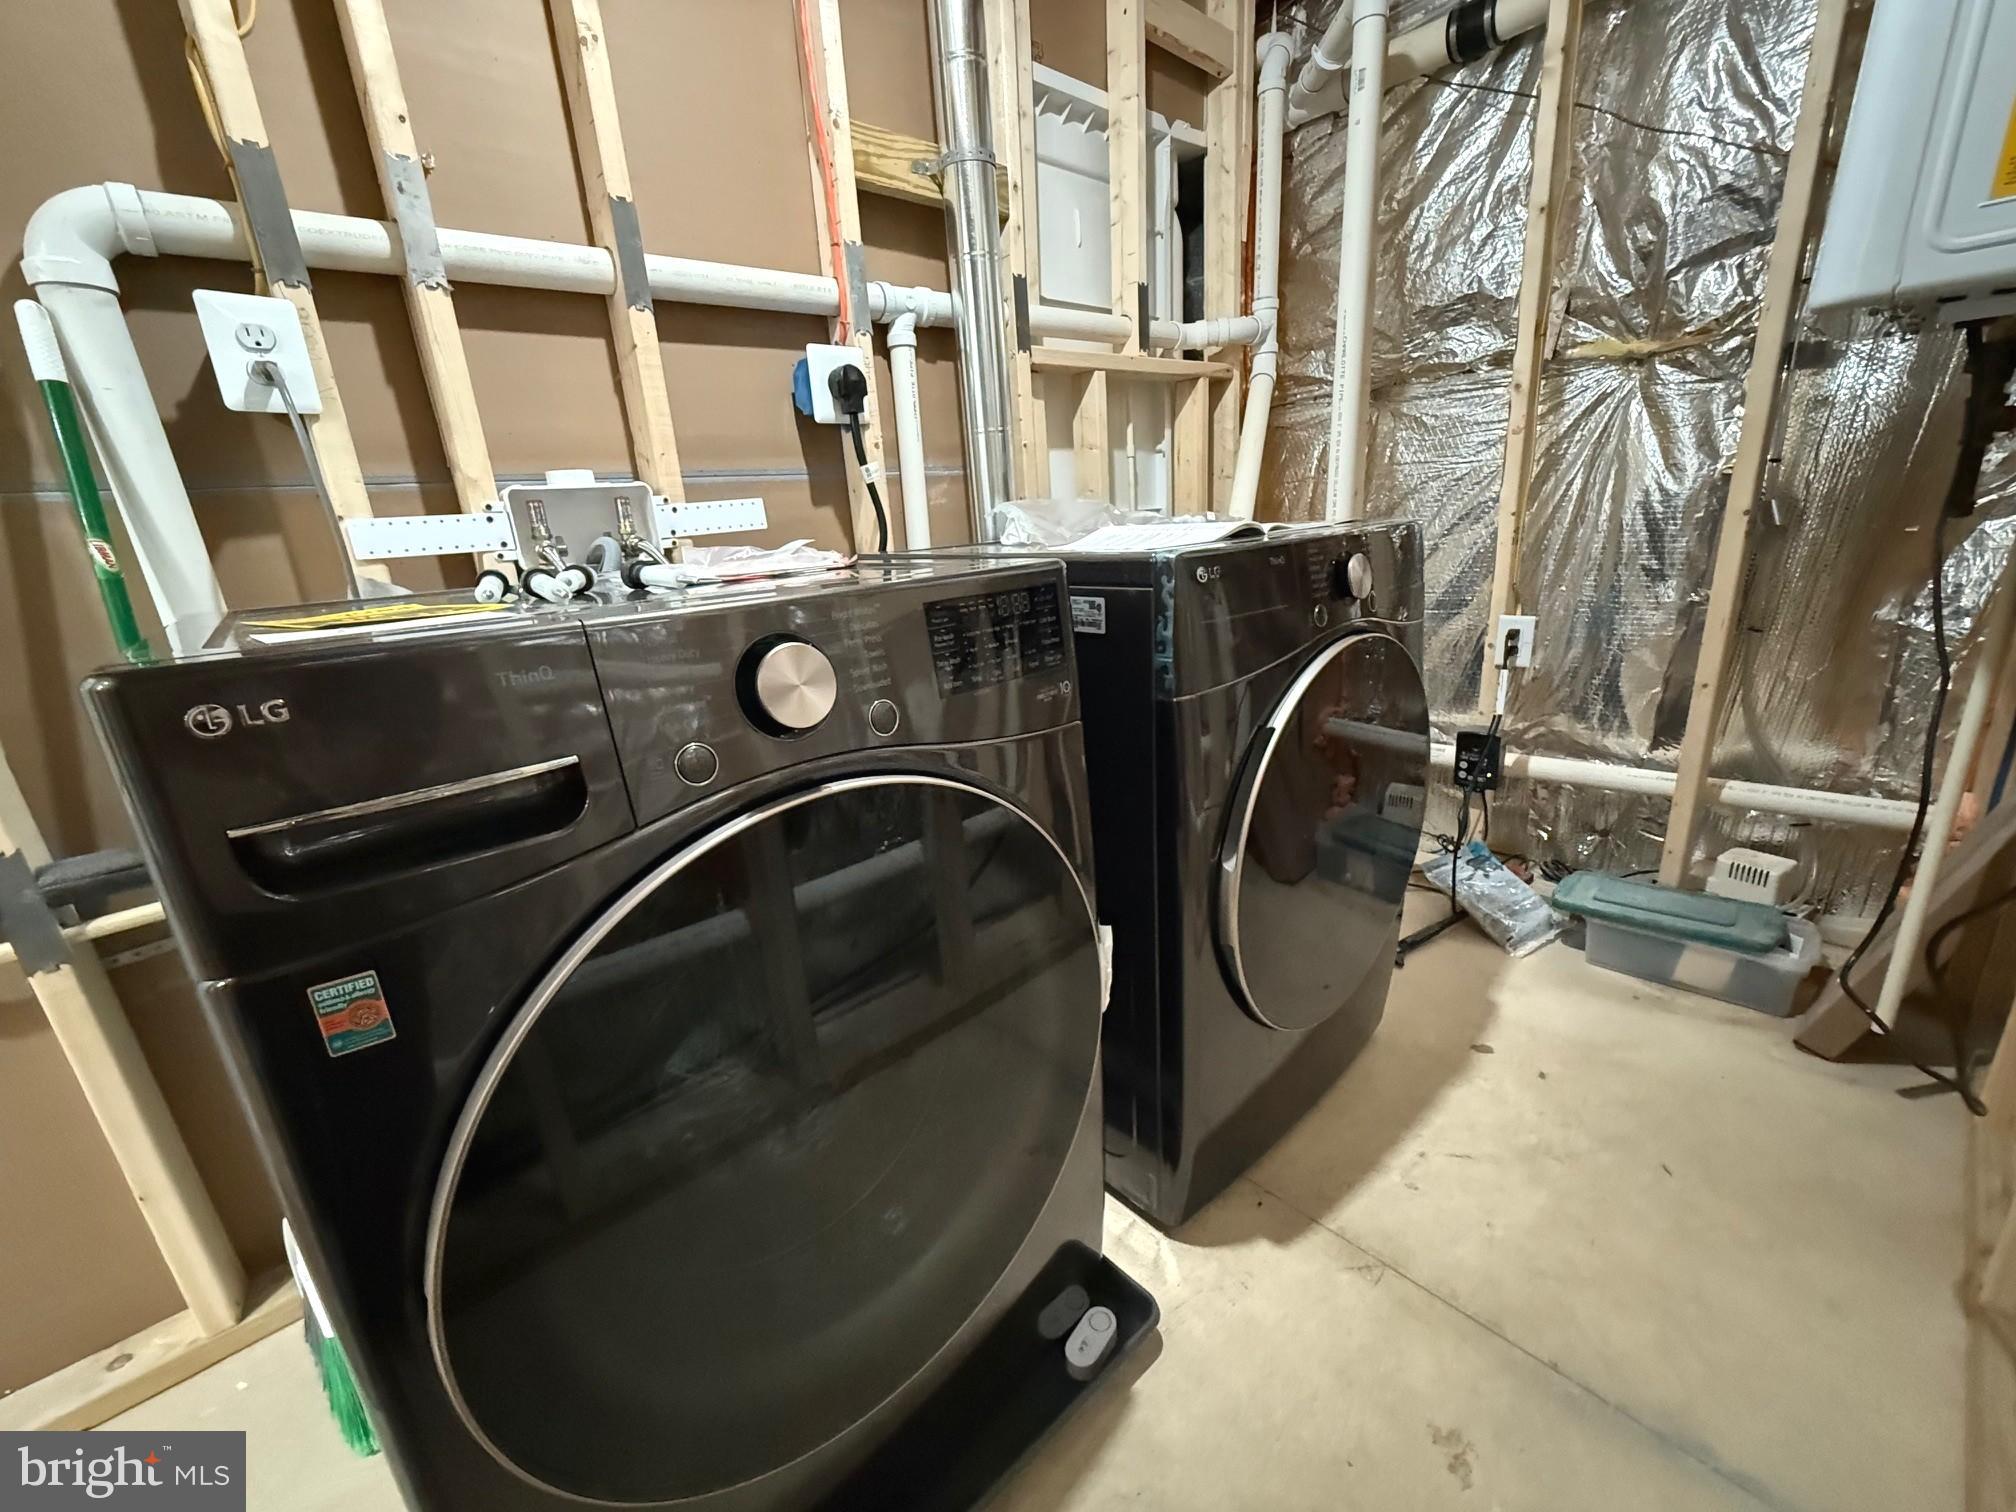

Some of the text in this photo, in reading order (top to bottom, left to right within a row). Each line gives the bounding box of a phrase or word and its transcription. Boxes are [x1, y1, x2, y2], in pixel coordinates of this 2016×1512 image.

[495, 665, 555, 687] ThinQ
[237, 698, 291, 727] LG
[314, 977, 375, 1001] CERTIFIED
